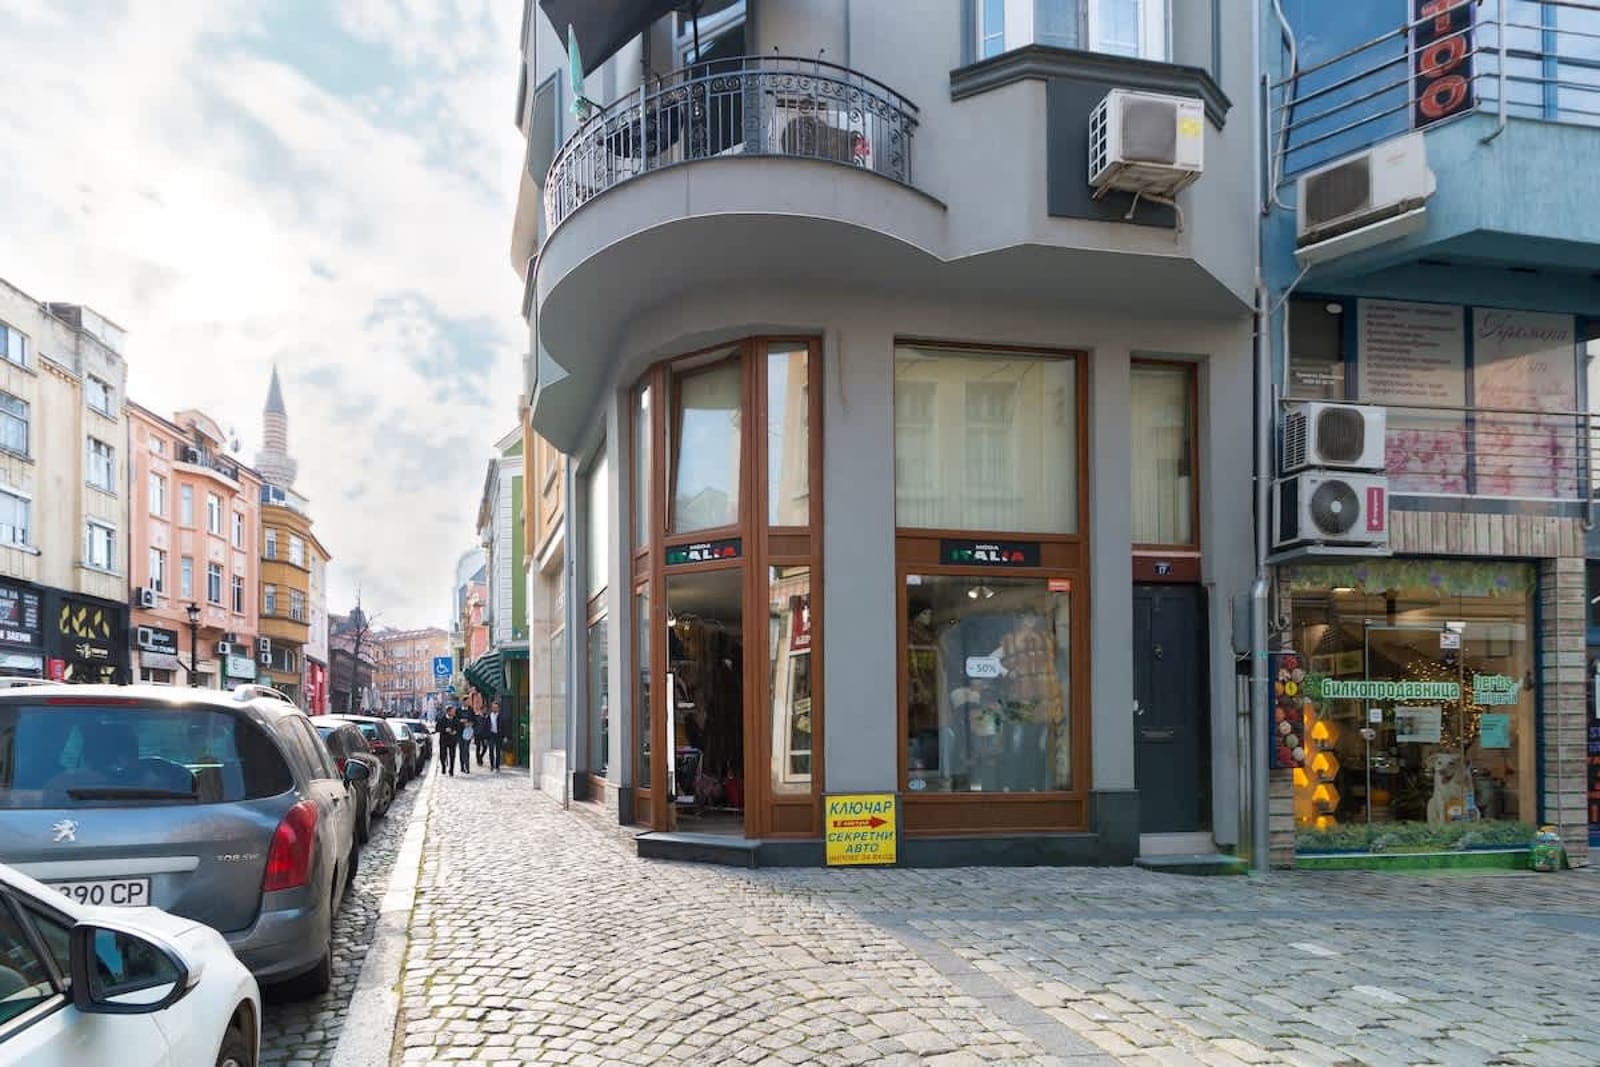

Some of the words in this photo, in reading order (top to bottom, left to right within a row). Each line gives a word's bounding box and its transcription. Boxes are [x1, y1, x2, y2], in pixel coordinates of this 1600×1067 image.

[669, 546, 736, 563] ITALIA
[950, 550, 1024, 562] ITALIA
[1322, 679, 1460, 699] билкопродавница
[830, 800, 893, 815] КЛЮЧАР
[828, 831, 893, 842] СЕКРЕТНИ
[845, 843, 879, 854] АВТО
[111, 882, 143, 904] CP
